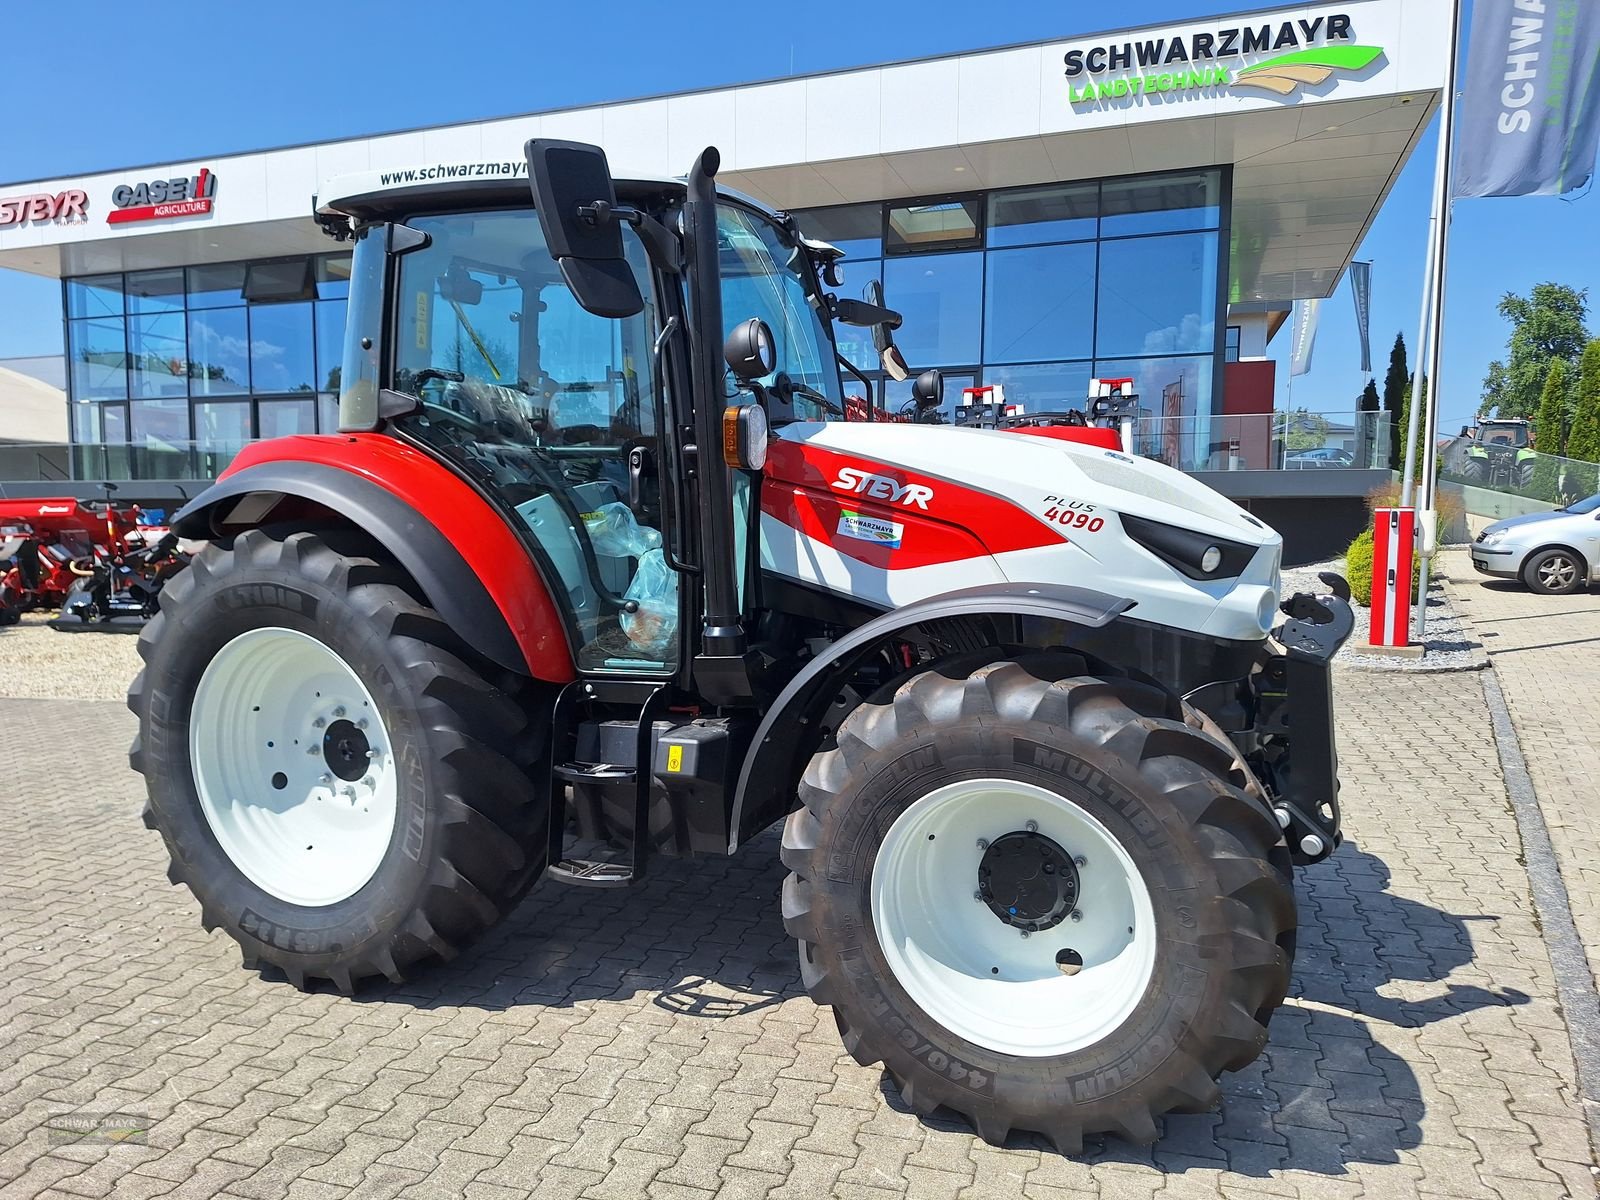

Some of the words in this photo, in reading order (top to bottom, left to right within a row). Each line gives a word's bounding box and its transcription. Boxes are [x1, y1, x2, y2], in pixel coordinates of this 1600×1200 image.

[1064, 14, 1350, 76] SCHWARZMAYR
[1068, 66, 1230, 103] LANDTECHNIK
[0, 189, 88, 225] STEYR
[112, 177, 188, 207] CASE
[154, 201, 206, 216] AGRICULTURE
[831, 467, 934, 510] STEYR
[1043, 495, 1097, 512] PLUS
[845, 517, 894, 534] SCHWARZMAYR
[1043, 506, 1105, 533] 4090
